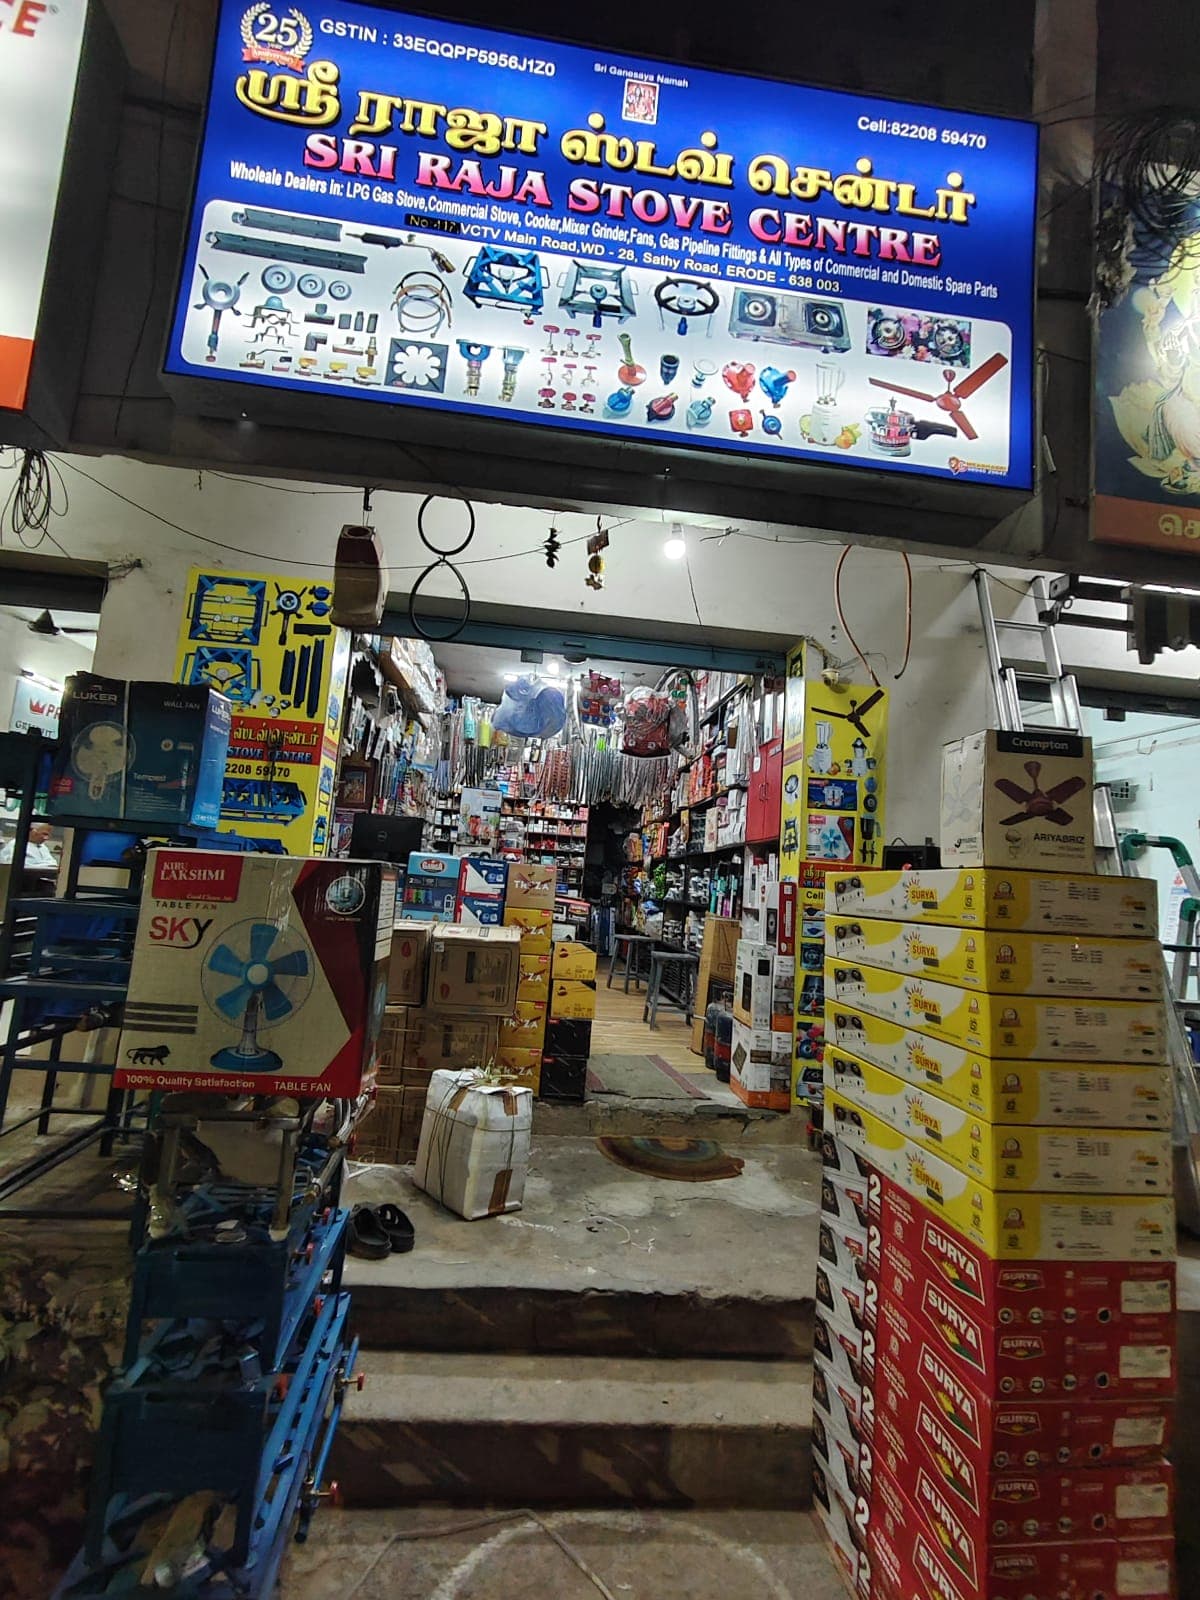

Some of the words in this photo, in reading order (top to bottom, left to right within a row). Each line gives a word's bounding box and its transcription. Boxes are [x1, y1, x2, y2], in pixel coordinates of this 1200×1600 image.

[254, 13, 298, 46] 25
[319, 18, 377, 43] GSTIN
[349, 90, 547, 154] ராஜா
[561, 112, 733, 186] ஸ்டவ்
[941, 129, 987, 149] 59470
[303, 133, 399, 181] SRI
[415, 151, 552, 208] RAJA
[568, 178, 732, 234] STOVE
[749, 208, 942, 267] CENTRE
[230, 160, 282, 186] Wholeale
[285, 171, 327, 194] Dealers
[346, 182, 370, 201] LPG
[372, 186, 394, 205] Gas
[490, 206, 521, 228] Stove,
[659, 232, 680, 251] Gas
[682, 236, 720, 257] Pipeline
[722, 242, 758, 264] Fittings
[759, 248, 768, 264] &
[769, 250, 782, 267] All
[784, 252, 811, 272] Types
[813, 257, 824, 273] of
[825, 258, 881, 281] Commercial
[882, 268, 899, 285] and
[901, 270, 944, 292] Domestic
[945, 277, 972, 296] Spare
[974, 281, 999, 299] Parts
[504, 230, 537, 246] Main
[618, 248, 638, 264] 28,
[642, 252, 680, 270] Sathy
[684, 258, 722, 276] Road,
[726, 265, 776, 284] ERODE
[788, 275, 813, 289] 638
[73, 692, 118, 702] LUKER
[227, 745, 264, 758] STOVE
[1012, 736, 1070, 751] Crompton
[160, 869, 225, 881] LAKSHMI
[155, 900, 192, 910] TABLE
[911, 890, 935, 900] SURYA
[149, 916, 214, 948] SKY
[912, 945, 936, 957] SURYA
[913, 998, 938, 1014] SURYA
[126, 1074, 155, 1085] 100%
[156, 1075, 193, 1088] Quality
[194, 1078, 255, 1088] Satisfaction
[274, 1081, 307, 1091] TABLE
[310, 1083, 331, 1092] FAN
[927, 1228, 977, 1282] SURYA
[927, 1288, 978, 1350] SURYA
[1002, 1338, 1041, 1349] SURYA
[924, 1352, 973, 1422] SURYA
[997, 1413, 1038, 1424] SURYA
[921, 1412, 971, 1487] SURYA
[996, 1481, 1036, 1492] SURYA
[919, 1476, 970, 1561] SURYA
